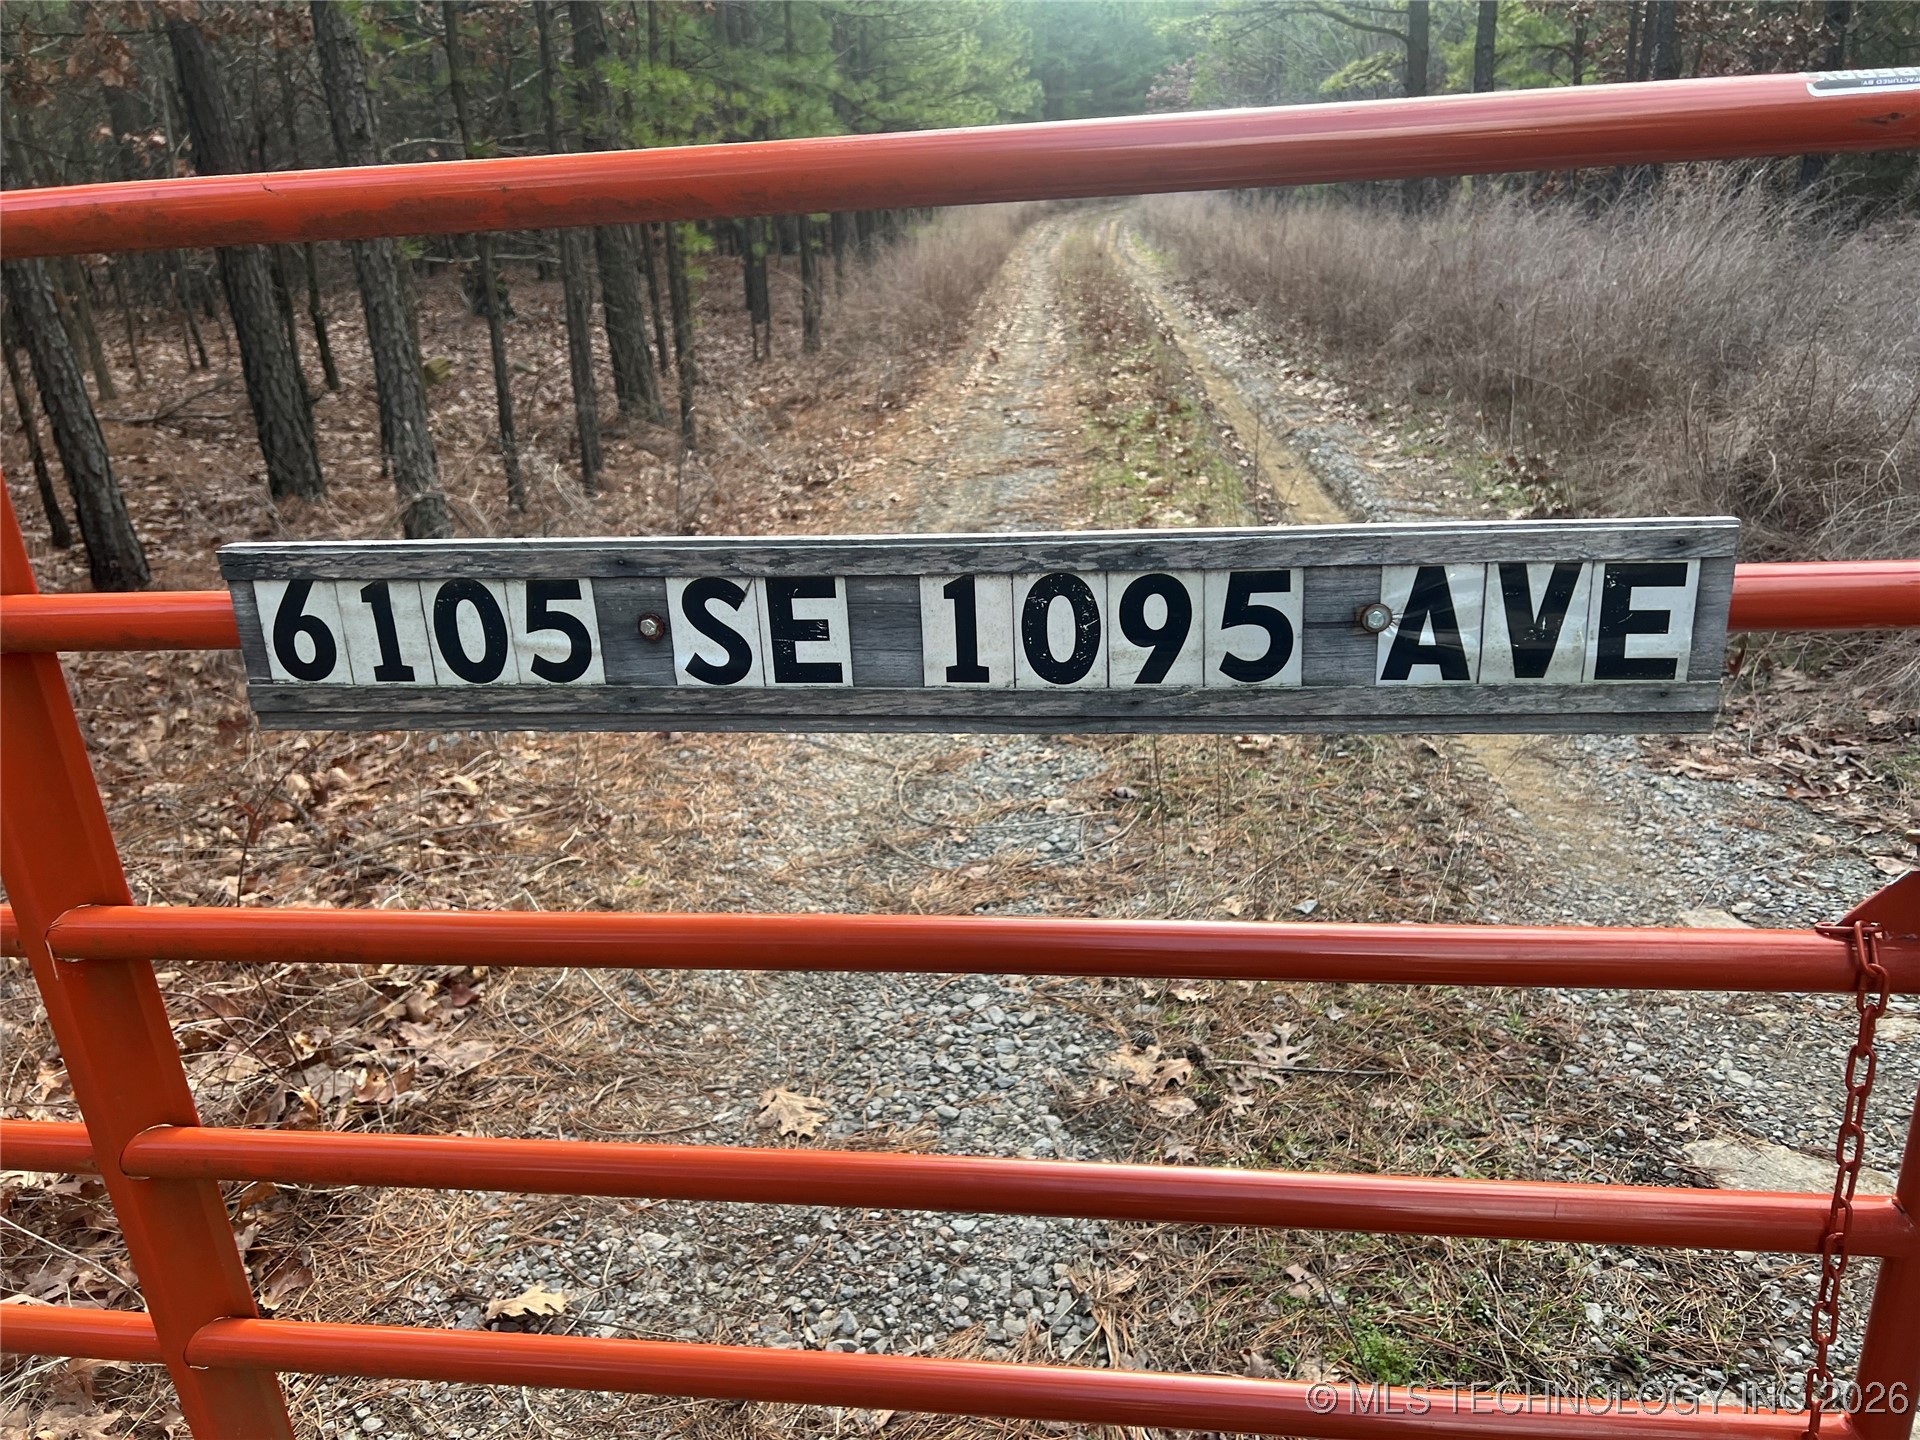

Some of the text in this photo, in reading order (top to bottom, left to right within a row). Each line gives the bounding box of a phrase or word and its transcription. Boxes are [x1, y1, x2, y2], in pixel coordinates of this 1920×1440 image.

[273, 562, 1688, 685] 6105 SE 1095 AVE
